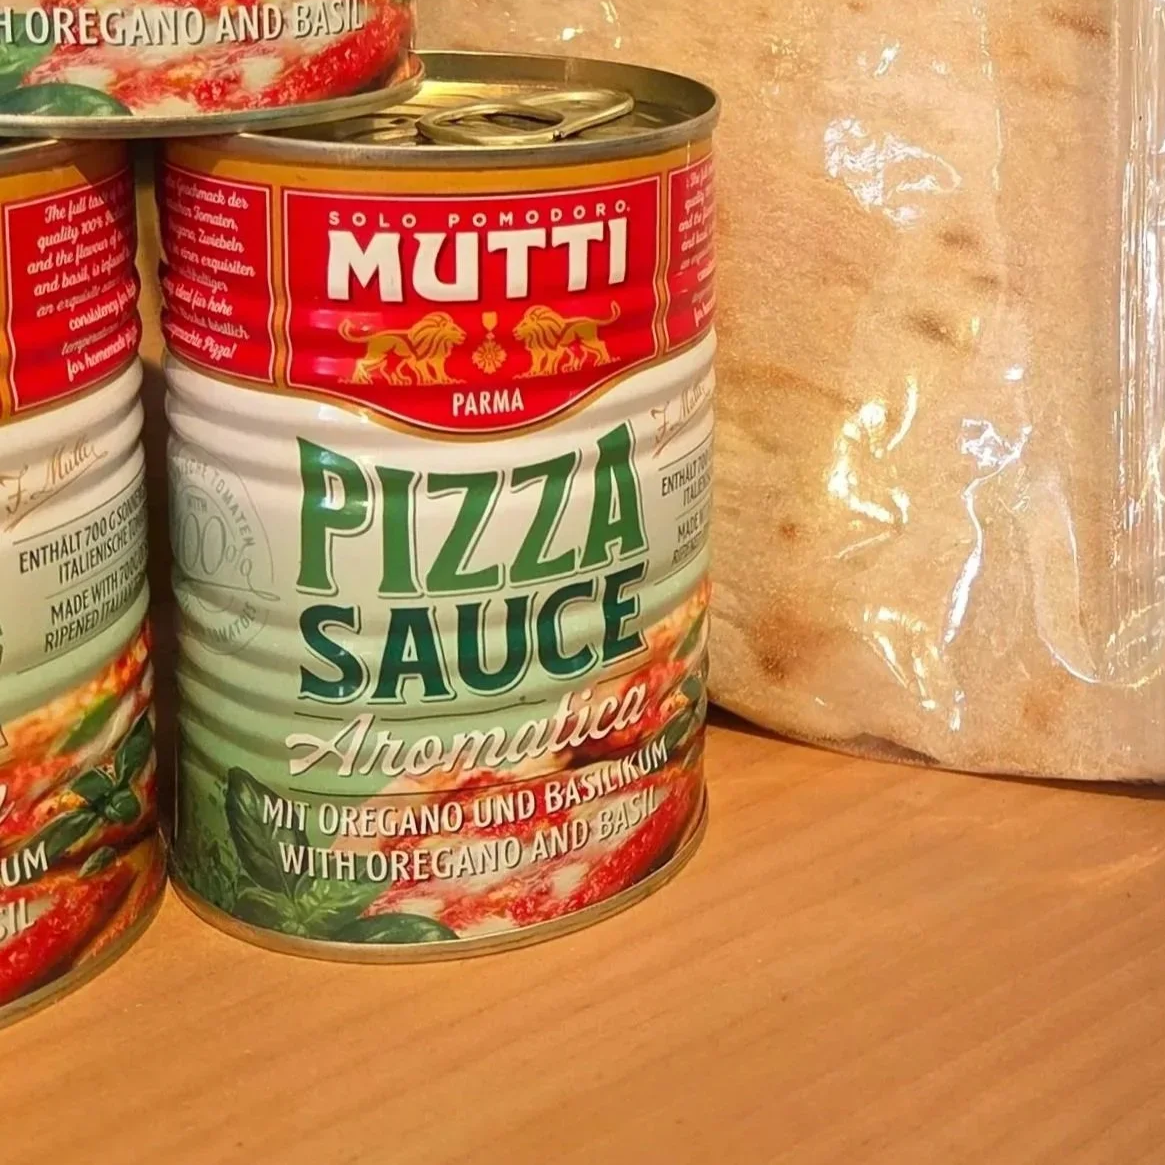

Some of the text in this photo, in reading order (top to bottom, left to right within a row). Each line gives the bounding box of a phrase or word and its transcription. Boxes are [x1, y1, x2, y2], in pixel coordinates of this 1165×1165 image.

[25, 6, 206, 48] OREGANO
[215, 6, 284, 45] AND
[44, 203, 67, 224] The
[68, 195, 87, 223] full
[228, 190, 249, 210] der
[328, 198, 627, 229] SOLO POMODORO
[37, 224, 79, 254] quality
[198, 227, 245, 254] Zwiebeln
[27, 252, 54, 275] and
[55, 249, 74, 267] the
[201, 255, 256, 278] exquisiten
[327, 216, 629, 303] MUTTI
[33, 273, 60, 297] and
[36, 302, 54, 318] an
[207, 295, 234, 317] hohe
[202, 335, 239, 361] Pizza!
[66, 358, 85, 383] for
[452, 387, 525, 417] PARMA
[210, 469, 256, 548] TOMATEN
[296, 421, 649, 598] PIZZA
[84, 518, 107, 547] 700
[677, 510, 699, 543] MADE
[58, 526, 129, 586] ITALIENISCHE
[51, 588, 89, 627] MADE
[90, 571, 119, 605] WITH
[44, 607, 99, 654] RIPENED
[298, 559, 650, 706] SAUCE
[285, 682, 647, 778] Aromatica
[262, 738, 670, 839] MIT OREGANO UND BASILIKUM
[279, 785, 661, 883] WITH OREGANO AND BASIL
